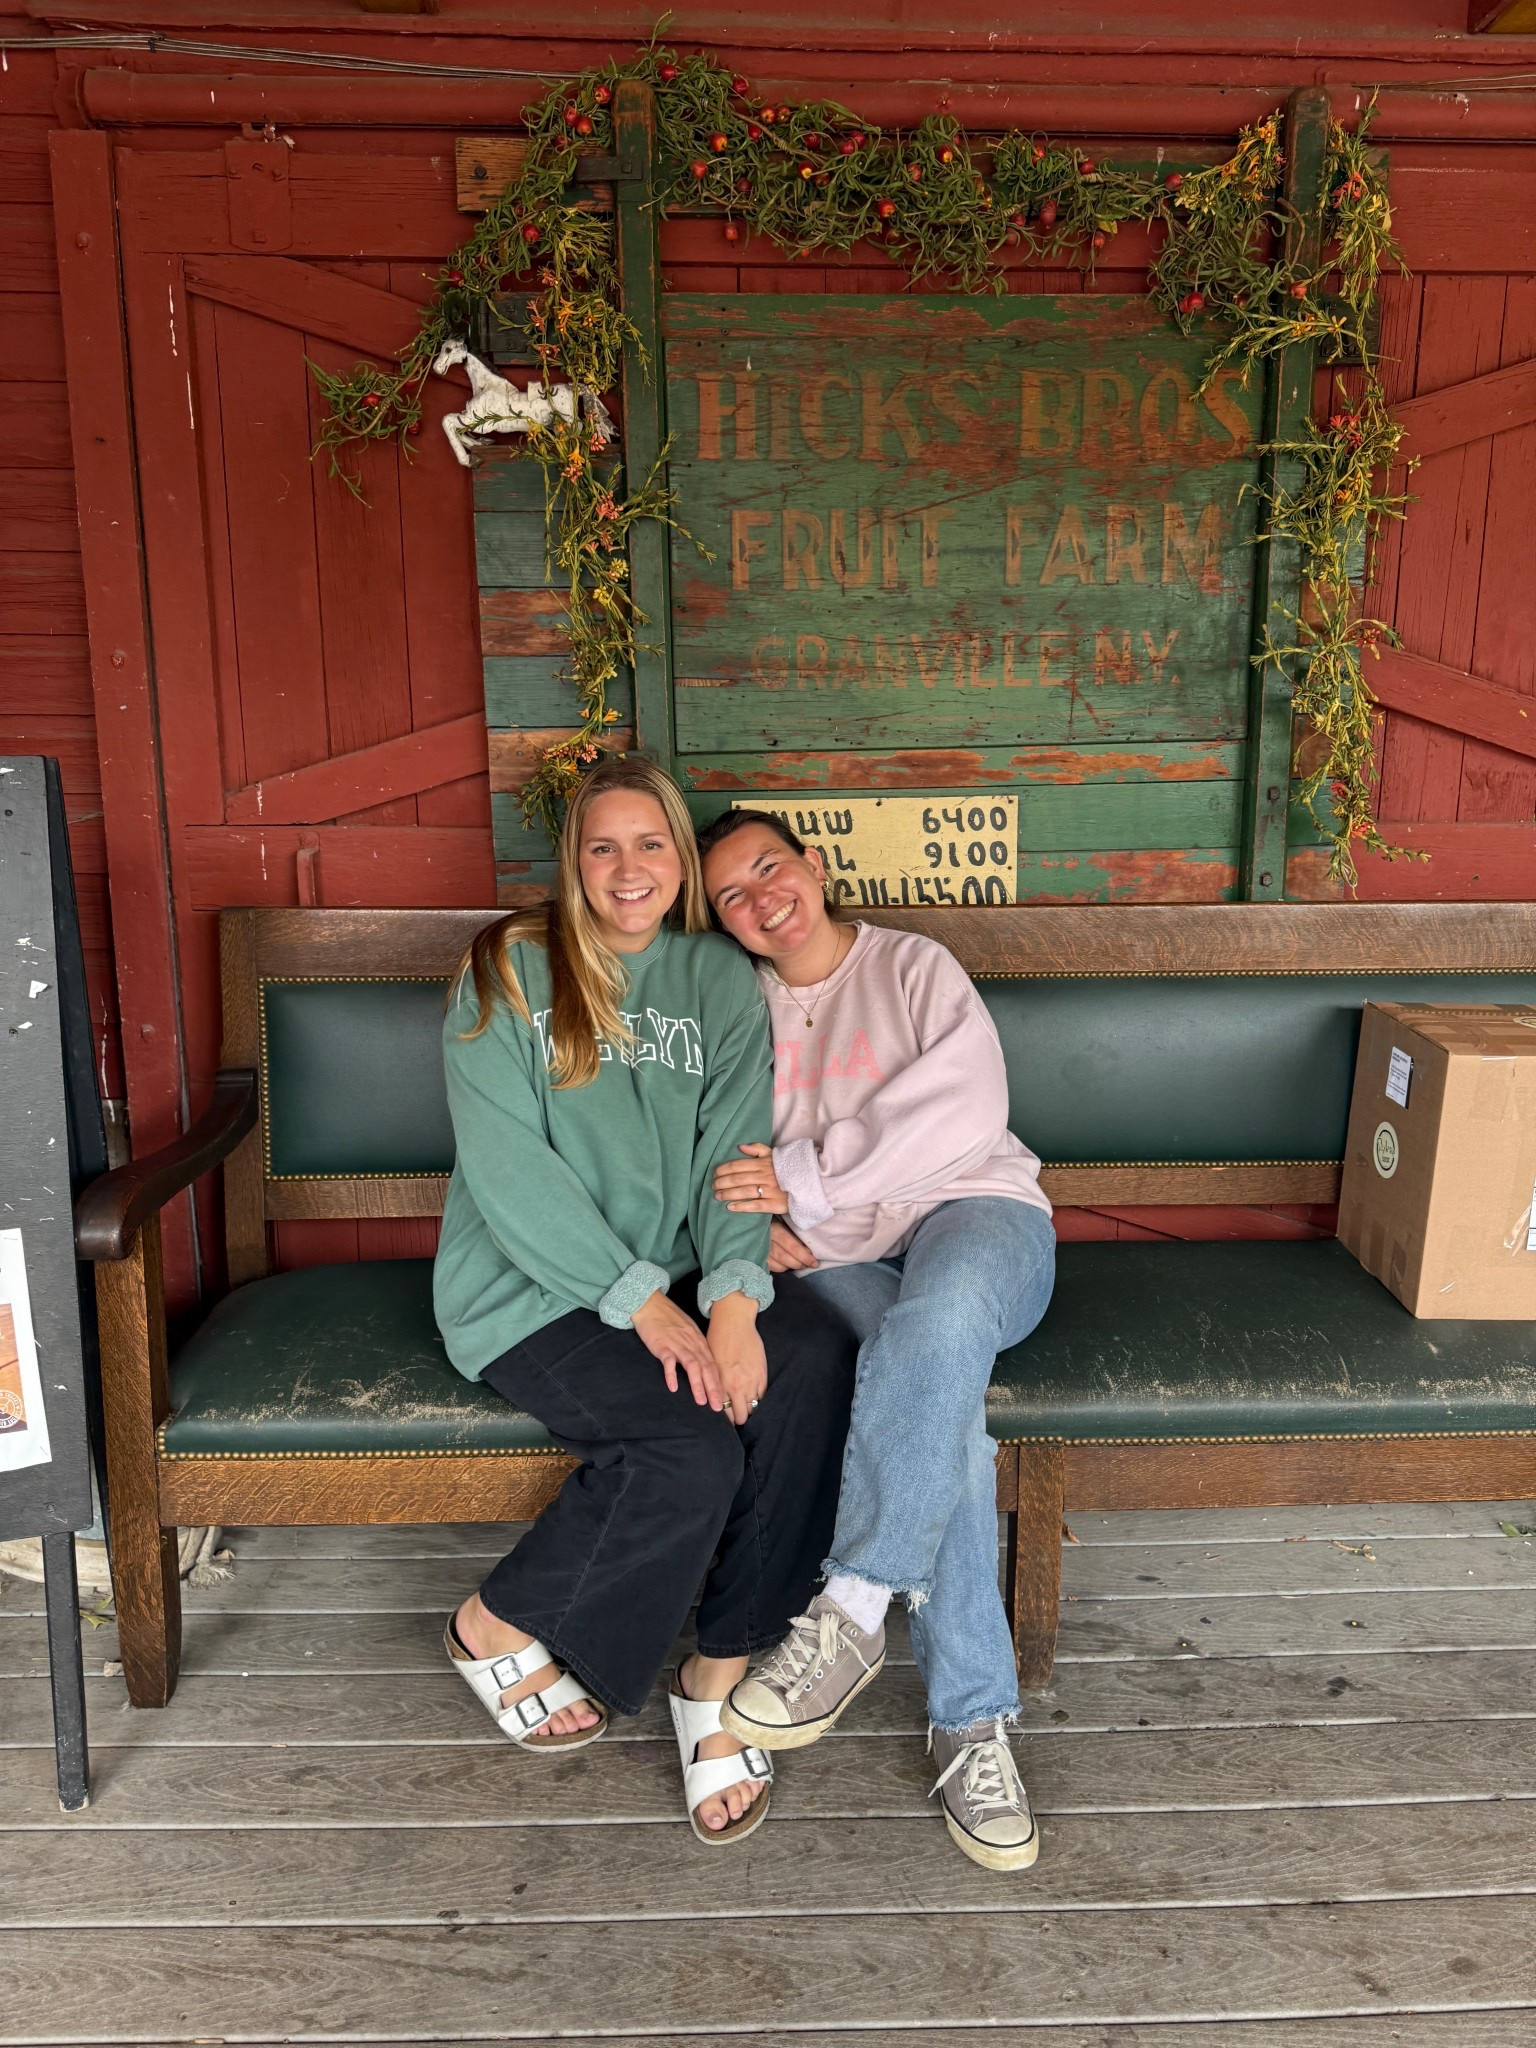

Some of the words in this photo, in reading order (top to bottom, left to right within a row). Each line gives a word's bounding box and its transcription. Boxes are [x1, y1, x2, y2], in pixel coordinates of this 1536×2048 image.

[694, 370, 990, 460] HICKS
[1020, 367, 1253, 460] BROS
[731, 507, 957, 591] FRUIT
[1004, 503, 1222, 586] FARM
[750, 631, 1069, 689] GRANVILLE
[922, 805, 1009, 834] 6400
[924, 840, 1009, 868] 9100
